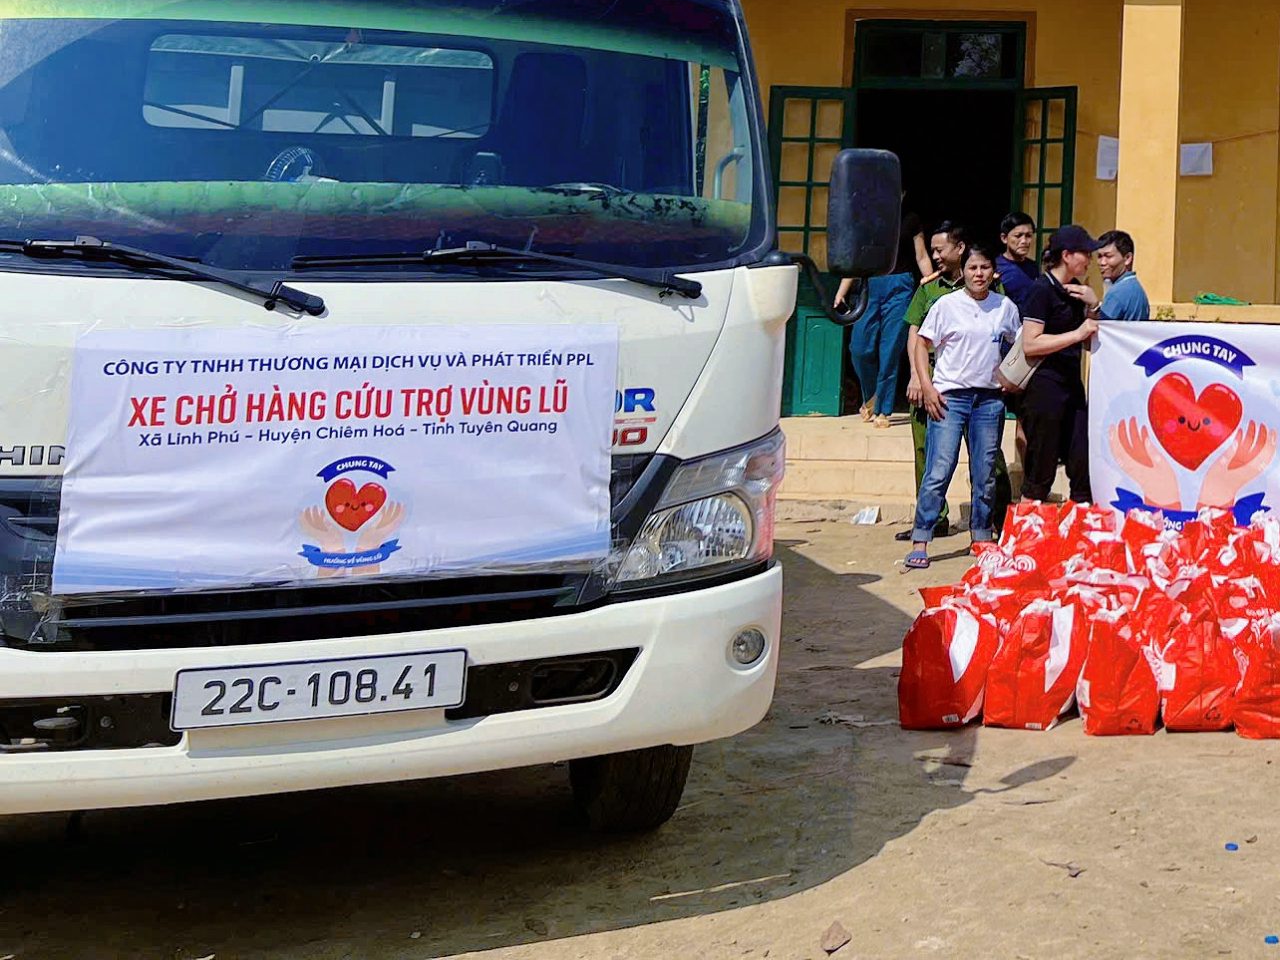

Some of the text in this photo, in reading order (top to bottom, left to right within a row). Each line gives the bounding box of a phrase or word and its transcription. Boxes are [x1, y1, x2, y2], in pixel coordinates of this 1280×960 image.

[103, 349, 595, 375] CÔNG TY TNHH THƯƠNG MẠI DỊCH VỤ VÀ PHÁT TRIỂN PPL
[1162, 341, 1237, 363] CHUNG TAY
[127, 378, 569, 428] XE CHỞ HÀNG CỨU TRỢ VÙNG LŨ
[615, 388, 656, 413] R
[138, 433, 162, 447] Xã
[167, 431, 202, 445] Linh
[208, 430, 239, 444] Phú
[259, 428, 311, 445] Huyện
[316, 426, 368, 439] Chiêm
[373, 424, 405, 438] Hoá
[458, 420, 503, 437] Tuyên
[507, 420, 557, 434] Quang
[336, 460, 384, 471] CHUNG TAY
[200, 662, 438, 716] 22C-108.41
